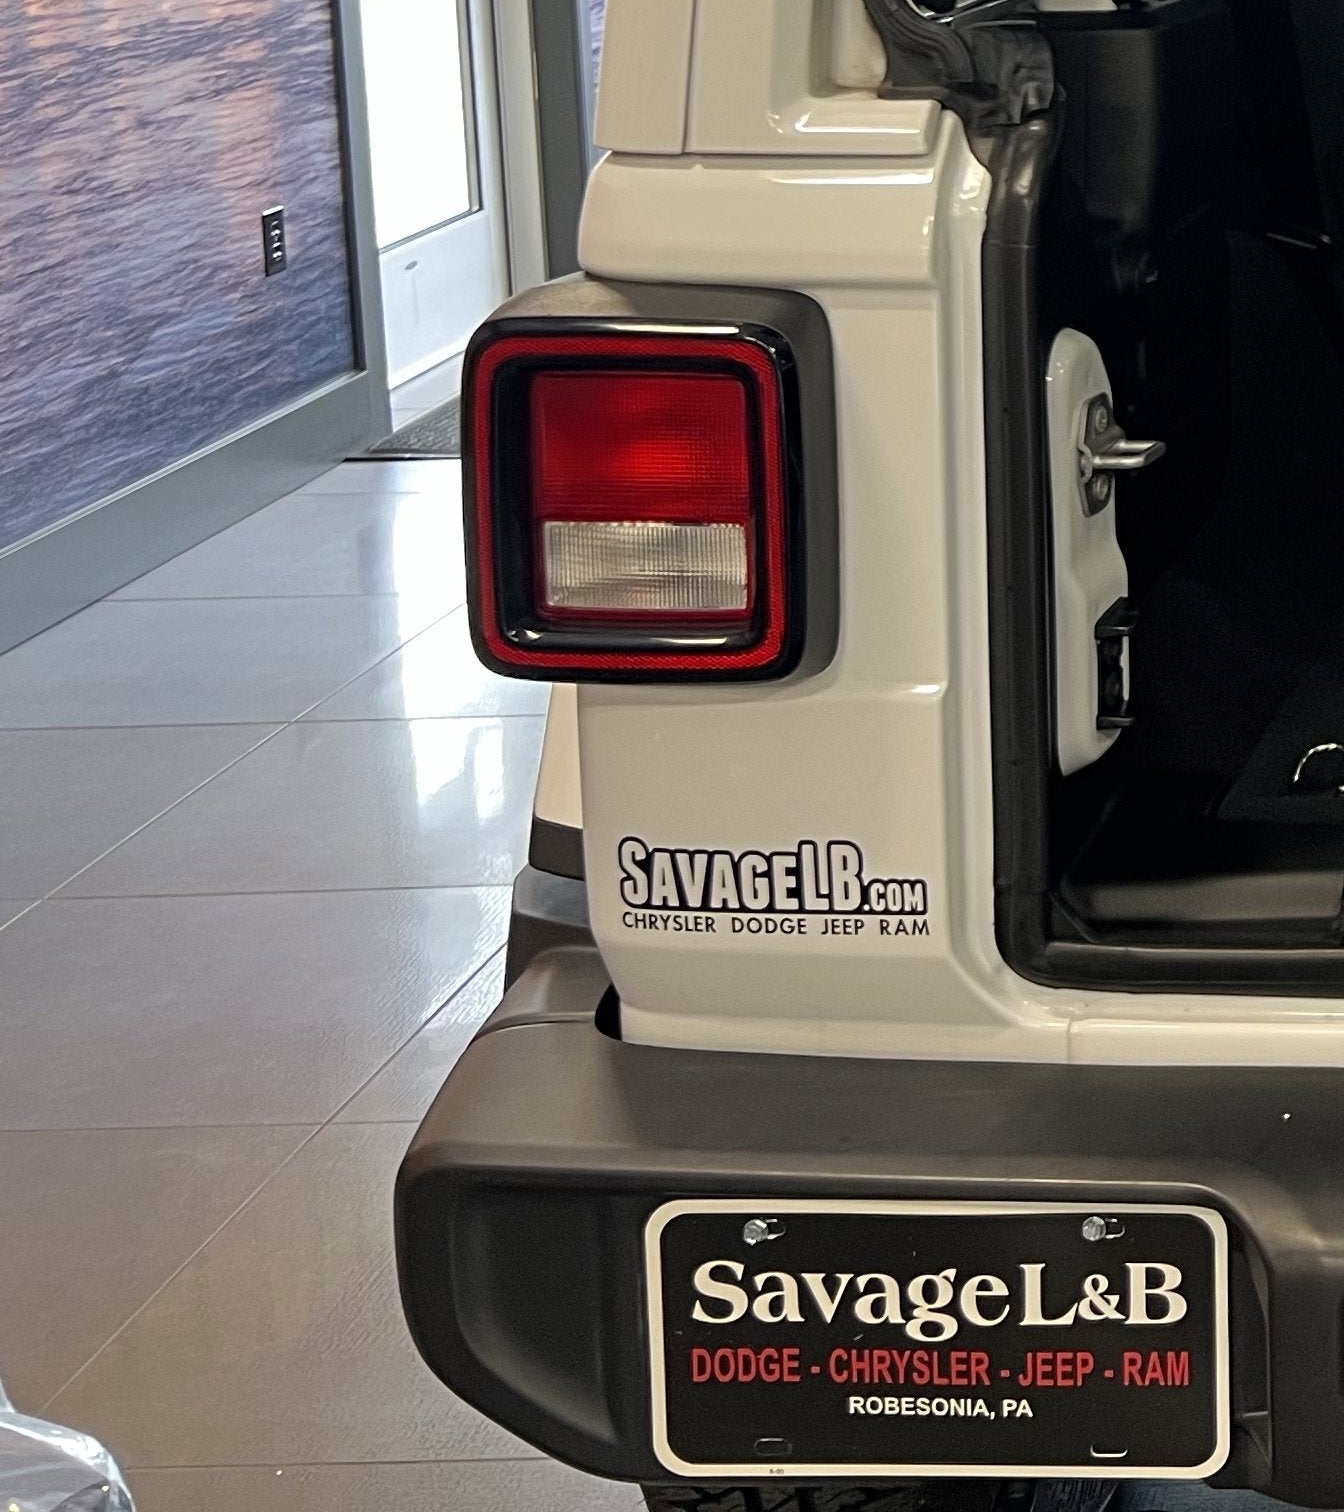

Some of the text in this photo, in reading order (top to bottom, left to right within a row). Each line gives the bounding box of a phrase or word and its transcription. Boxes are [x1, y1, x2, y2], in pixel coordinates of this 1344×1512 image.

[622, 912, 930, 936] CHRYSLER DODGE JEEP RAM
[691, 1347, 801, 1384] DODGE
[829, 1349, 991, 1386] CHRYSLER
[1018, 1350, 1094, 1387] JEEP
[1122, 1351, 1190, 1387] RAM
[848, 1396, 1034, 1420] ROBESONIA, PA
